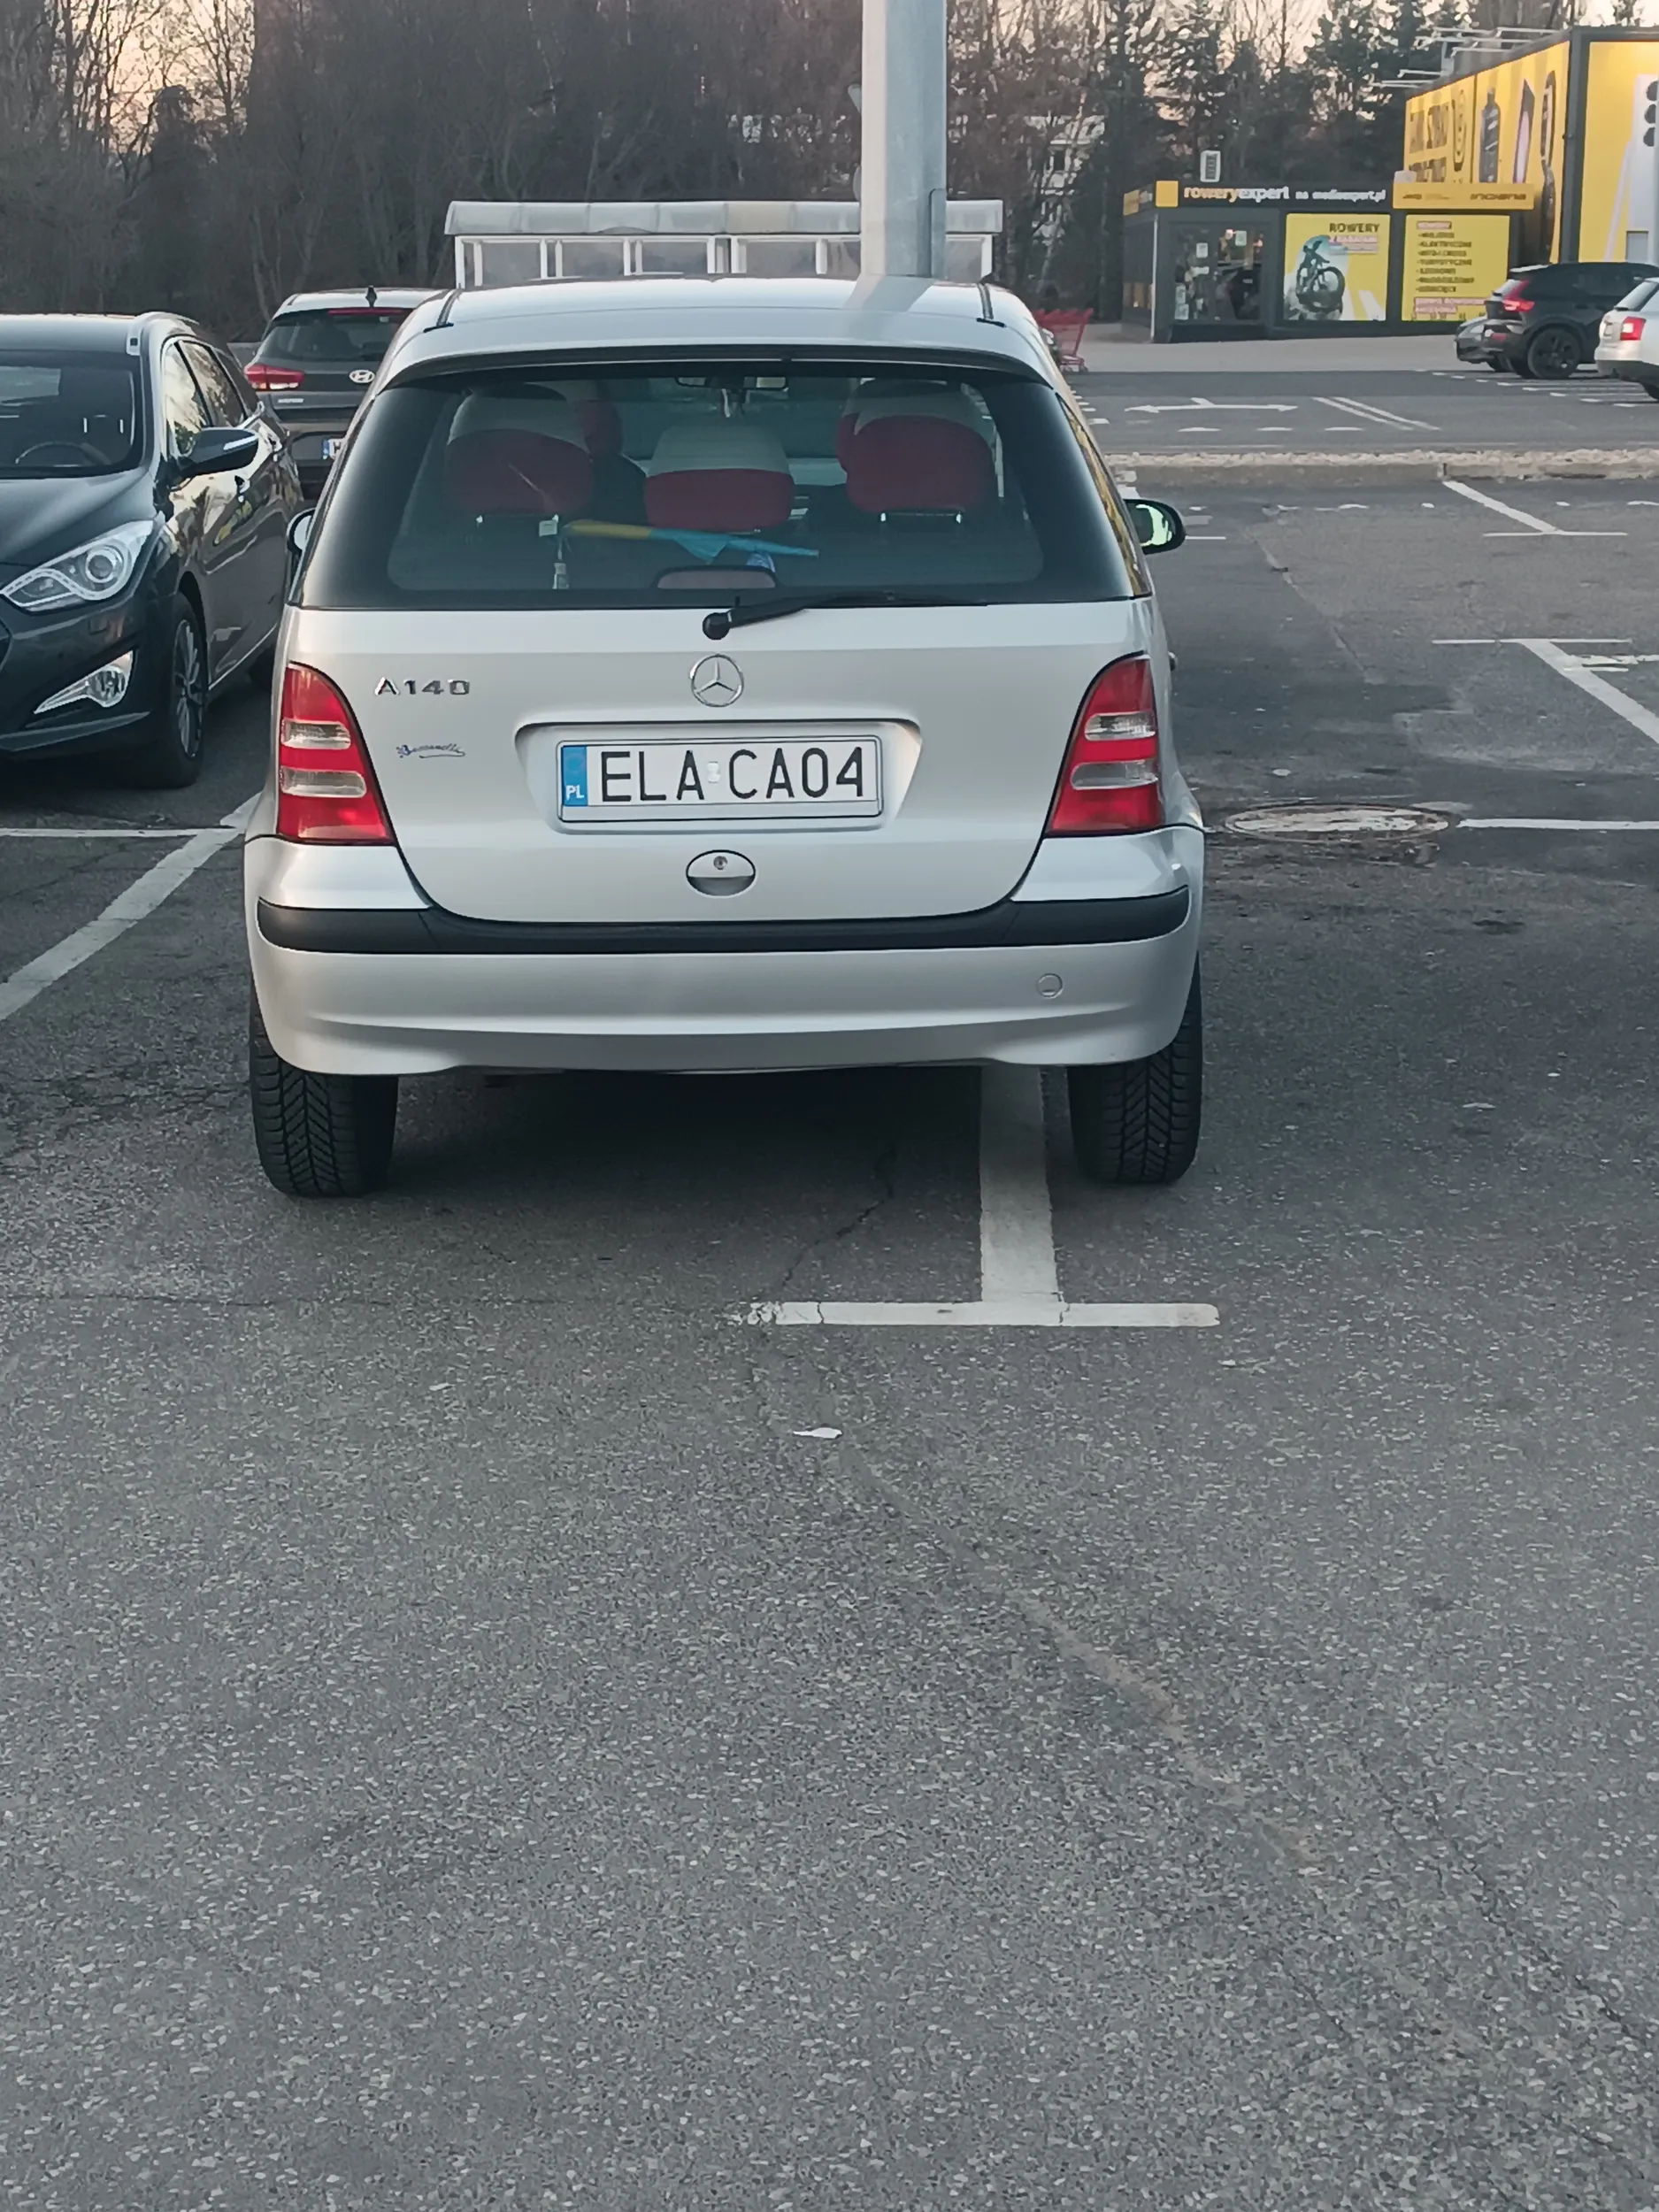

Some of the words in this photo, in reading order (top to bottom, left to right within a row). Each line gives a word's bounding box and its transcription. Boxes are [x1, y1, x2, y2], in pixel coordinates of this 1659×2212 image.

[1329, 222, 1380, 233] ROWERY
[374, 676, 470, 695] A140
[601, 749, 705, 803] ELA
[728, 746, 864, 800] CA04
[565, 784, 586, 801] PL
